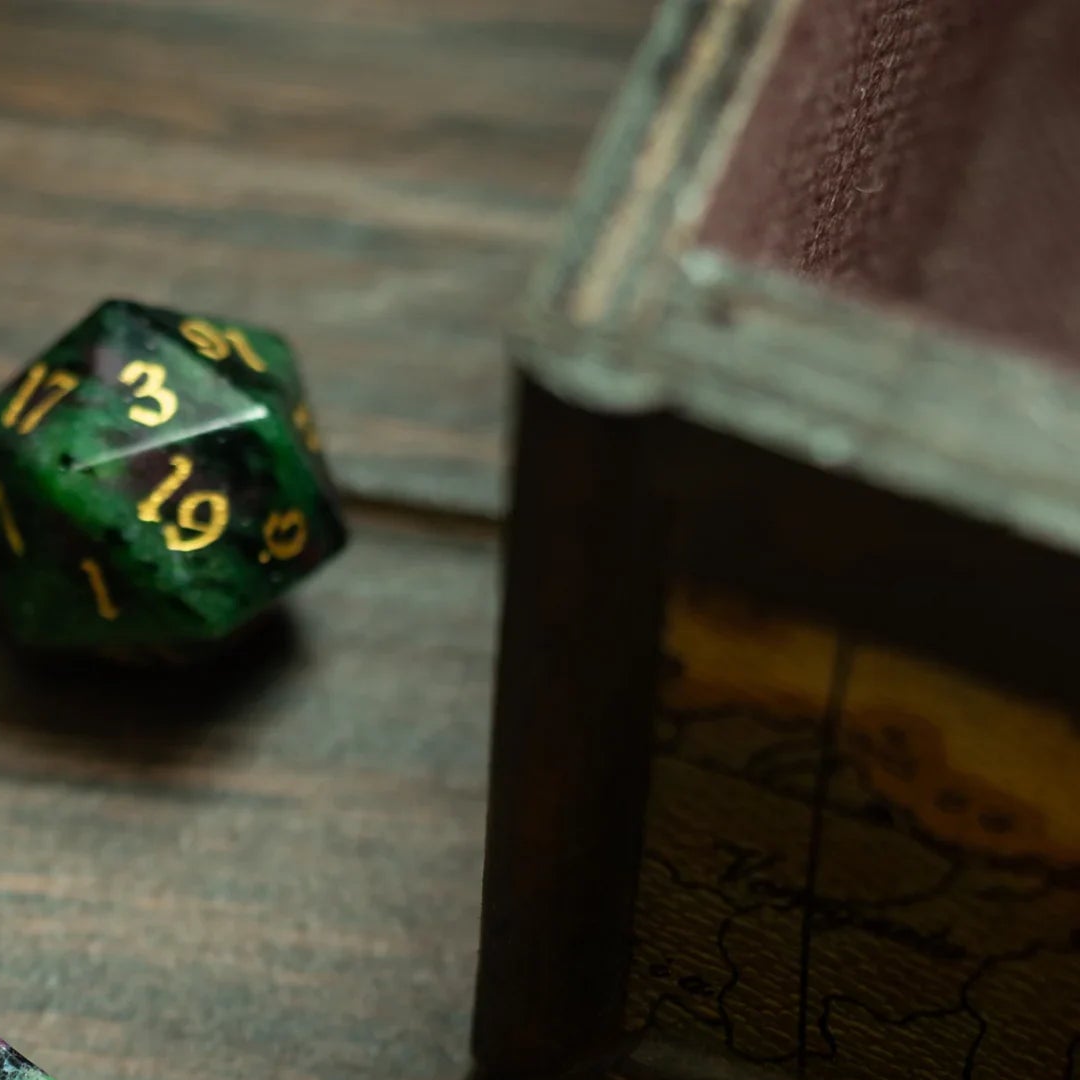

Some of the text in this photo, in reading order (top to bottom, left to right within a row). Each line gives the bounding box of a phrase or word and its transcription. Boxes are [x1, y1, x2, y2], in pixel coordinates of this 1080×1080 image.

[1, 362, 79, 435] 17
[120, 360, 178, 427] 3
[137, 456, 230, 552] 19
